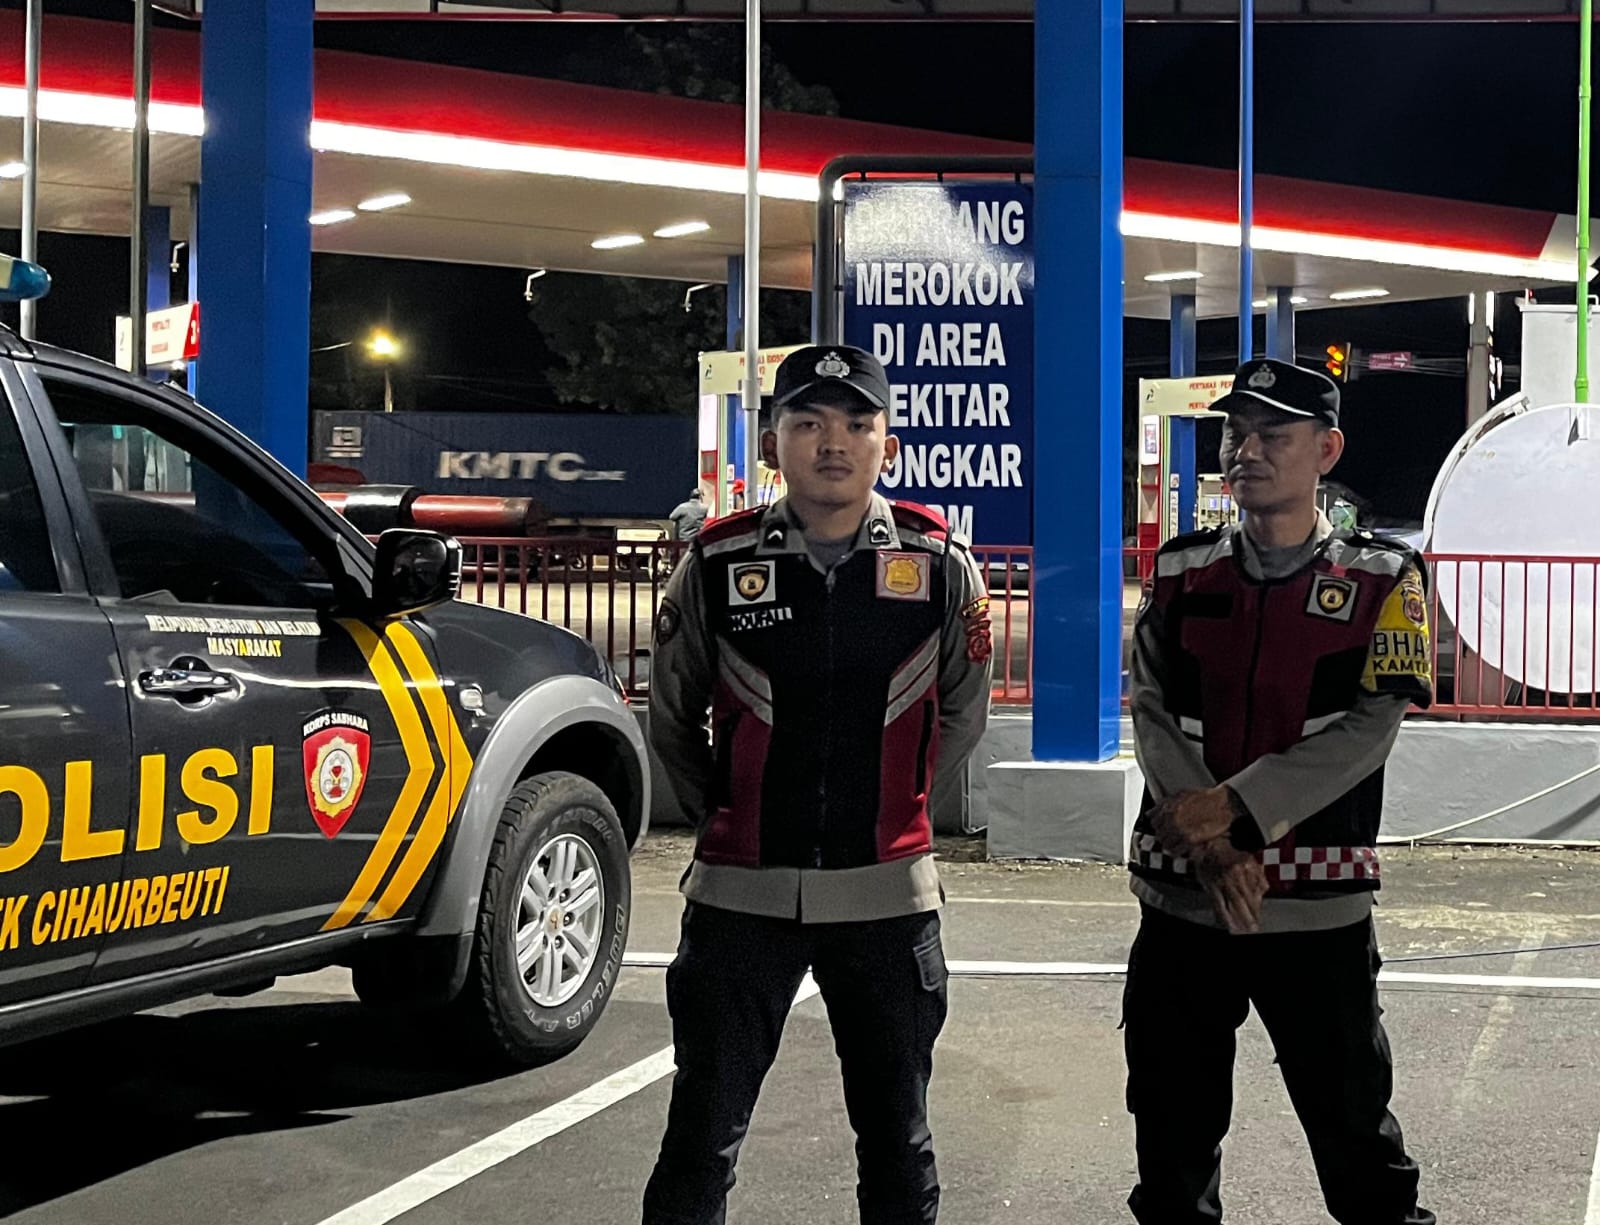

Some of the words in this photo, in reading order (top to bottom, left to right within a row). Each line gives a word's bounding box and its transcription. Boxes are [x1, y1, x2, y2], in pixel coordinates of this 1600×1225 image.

[856, 262, 1024, 306] MEROKOK
[873, 323, 905, 366] DI
[915, 323, 1006, 366] AREA
[889, 384, 1011, 427] EKITAR
[438, 451, 585, 481] KMTC
[880, 444, 1023, 488] ONGKAR
[207, 637, 281, 657] MASYARAKAT
[1373, 659, 1428, 673] KAMTI
[1374, 632, 1425, 658] BHA
[303, 714, 330, 737] KORPS
[331, 713, 369, 731] SABHARA
[0, 745, 274, 873] OLISI
[31, 866, 230, 946] CIHAURBEUTI
